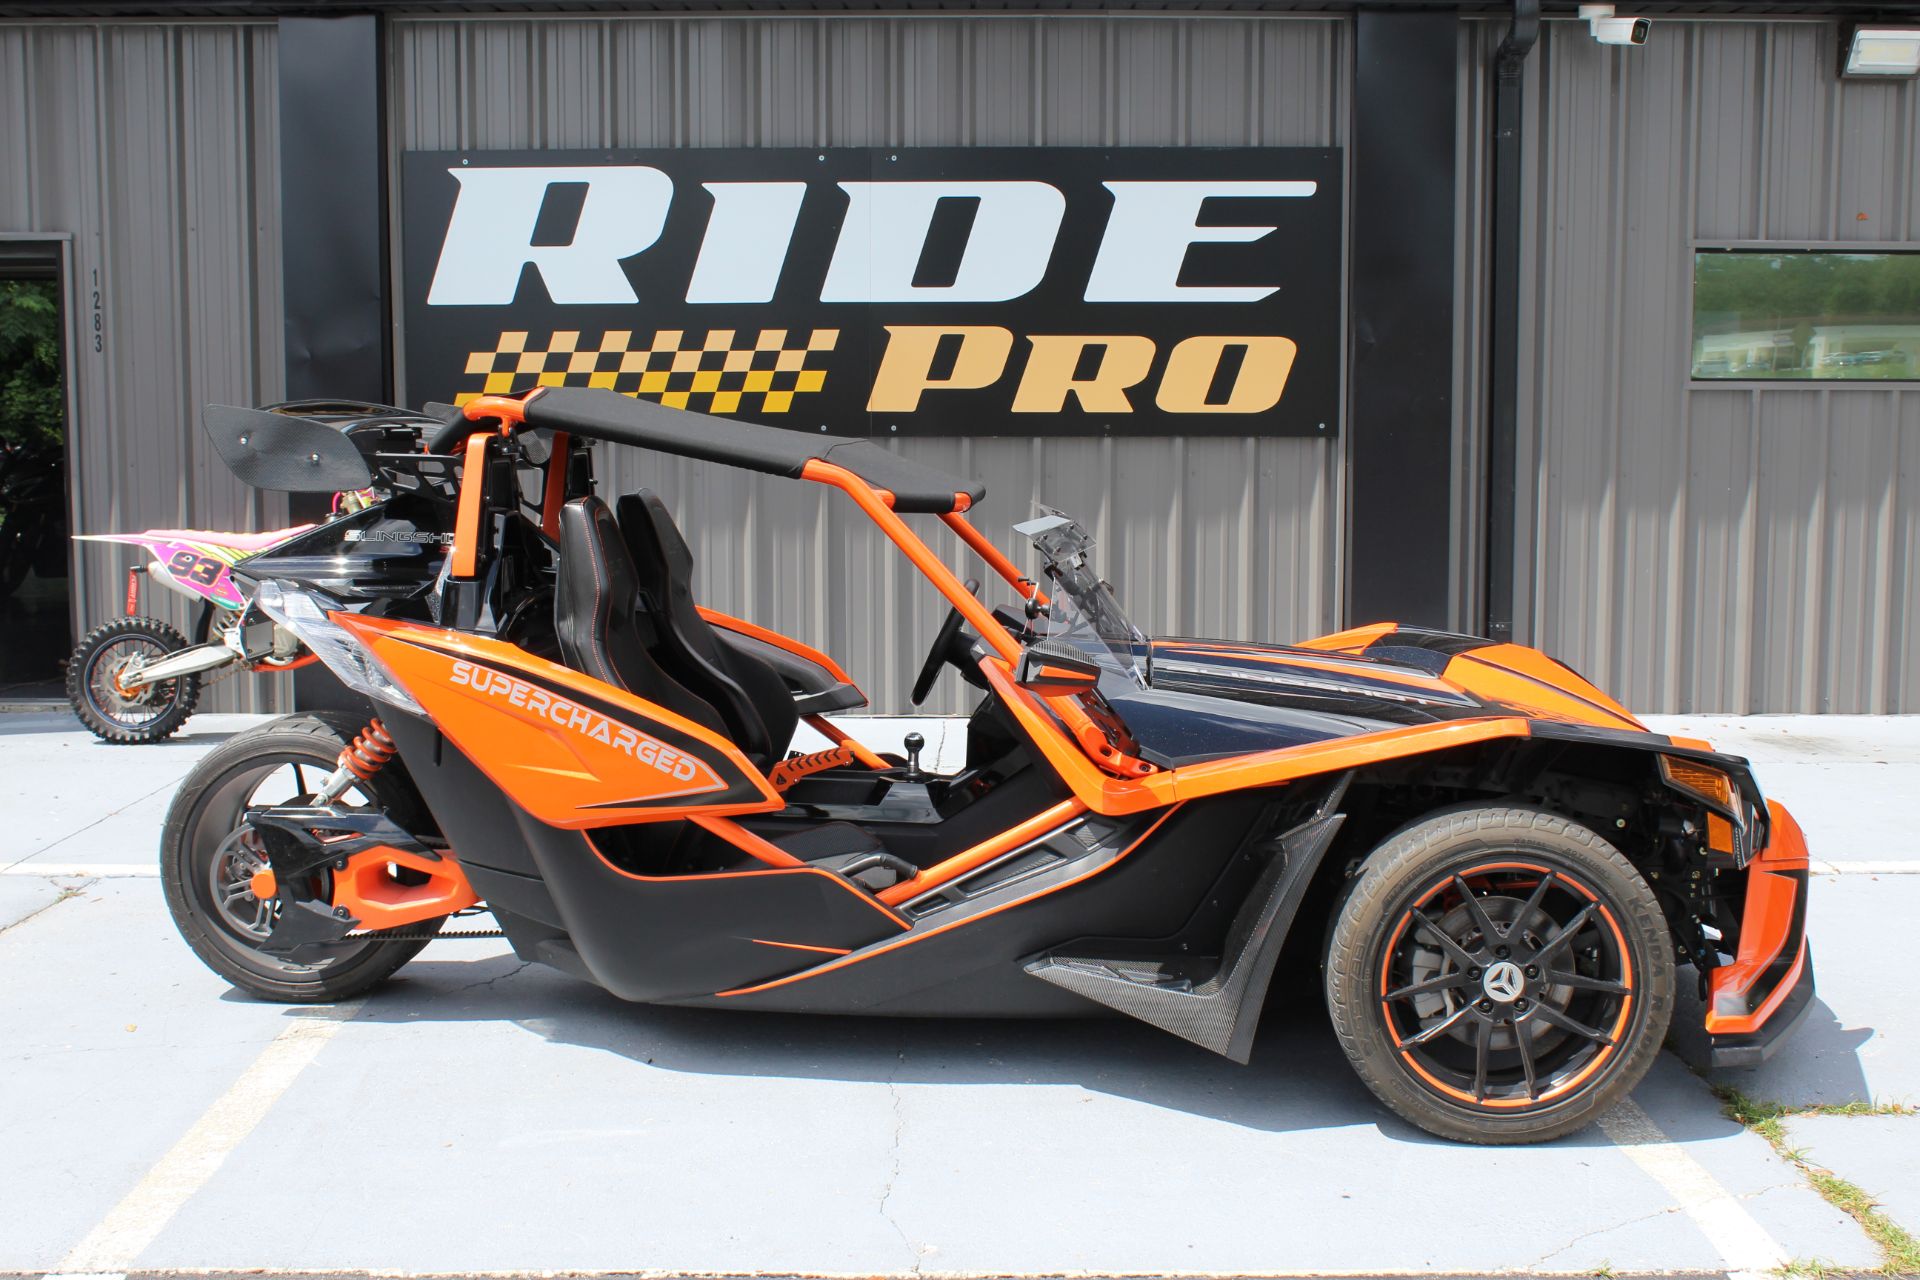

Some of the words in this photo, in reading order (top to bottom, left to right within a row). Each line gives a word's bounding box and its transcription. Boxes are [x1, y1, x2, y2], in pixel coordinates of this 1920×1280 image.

[427, 165, 1317, 305] RIDE
[92, 268, 103, 353] 1283
[866, 326, 1297, 414] PRO
[167, 550, 226, 588] 93
[450, 661, 698, 782] SUPERCHARGED
[1627, 896, 1666, 977] KENDA
